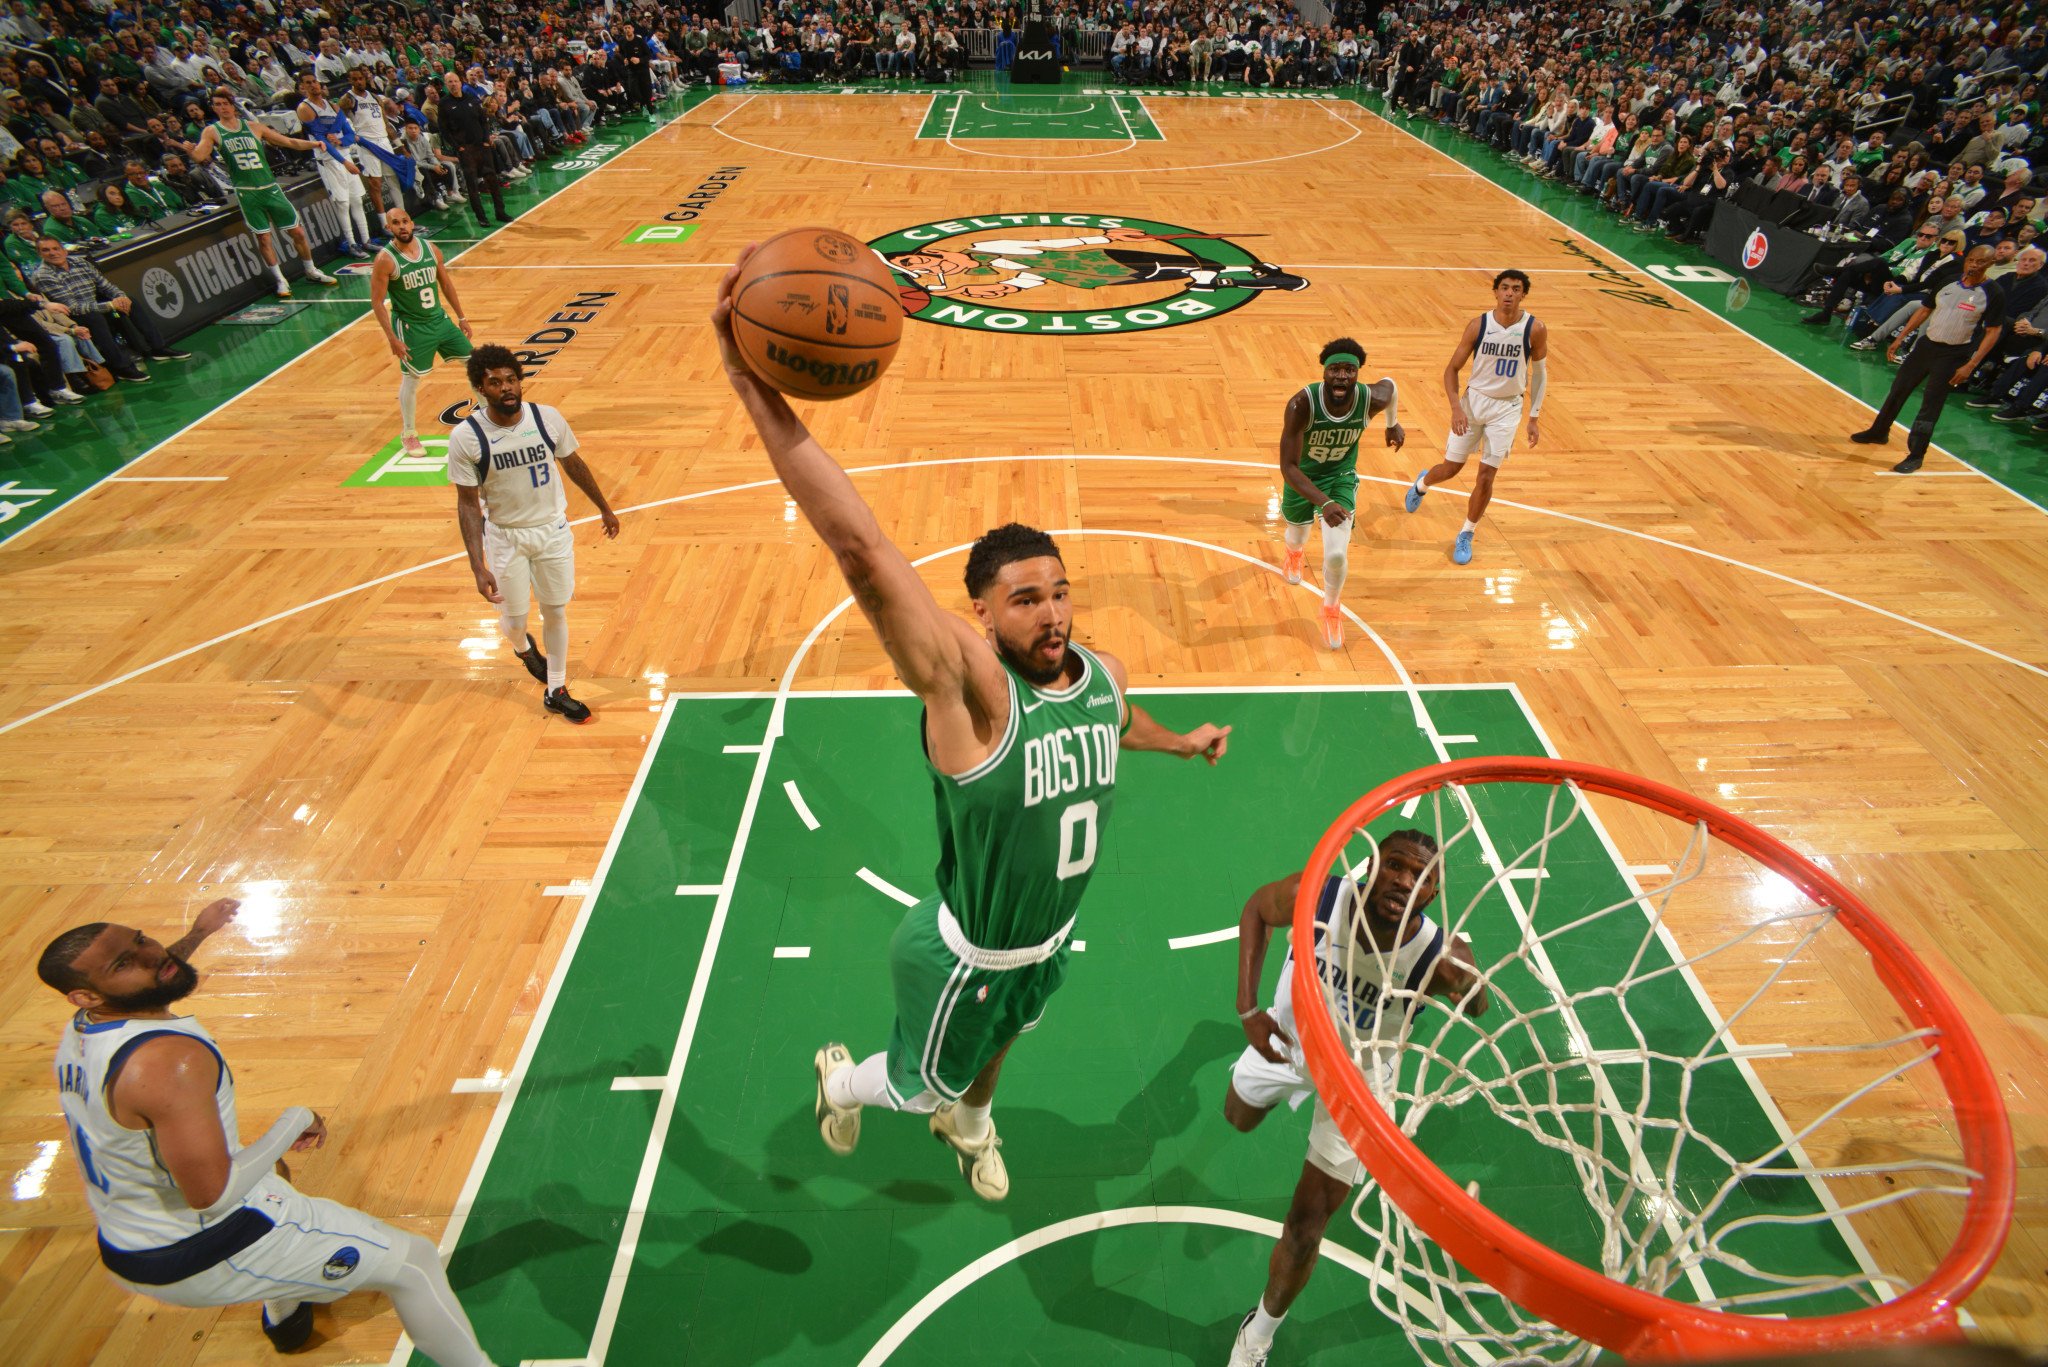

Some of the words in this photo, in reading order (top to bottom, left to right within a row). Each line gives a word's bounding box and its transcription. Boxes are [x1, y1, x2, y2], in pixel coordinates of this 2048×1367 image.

[1018, 50, 1053, 60] KIA
[1082, 89, 1210, 97] BOSTON
[1222, 91, 1339, 99] CELTICS
[223, 136, 258, 153] BOSTON
[576, 143, 621, 160] AT&T
[233, 152, 264, 171] 52
[661, 166, 748, 222] GARDEN
[902, 215, 1124, 241] CELTICS
[175, 232, 262, 304] TICKETS
[311, 198, 341, 243] NO
[402, 266, 437, 291] BOSTON
[419, 287, 436, 309] 9
[929, 298, 1217, 331] BOSTON
[1481, 341, 1522, 358] DALLAS
[766, 339, 880, 386] Wilson
[1495, 358, 1519, 378] 00
[1308, 428, 1362, 446] BOSTON
[492, 443, 547, 471] DALLAS
[528, 463, 550, 488] 13
[1086, 693, 1114, 708] Amica
[1024, 723, 1120, 808] BOSTON
[1056, 799, 1099, 882] 0
